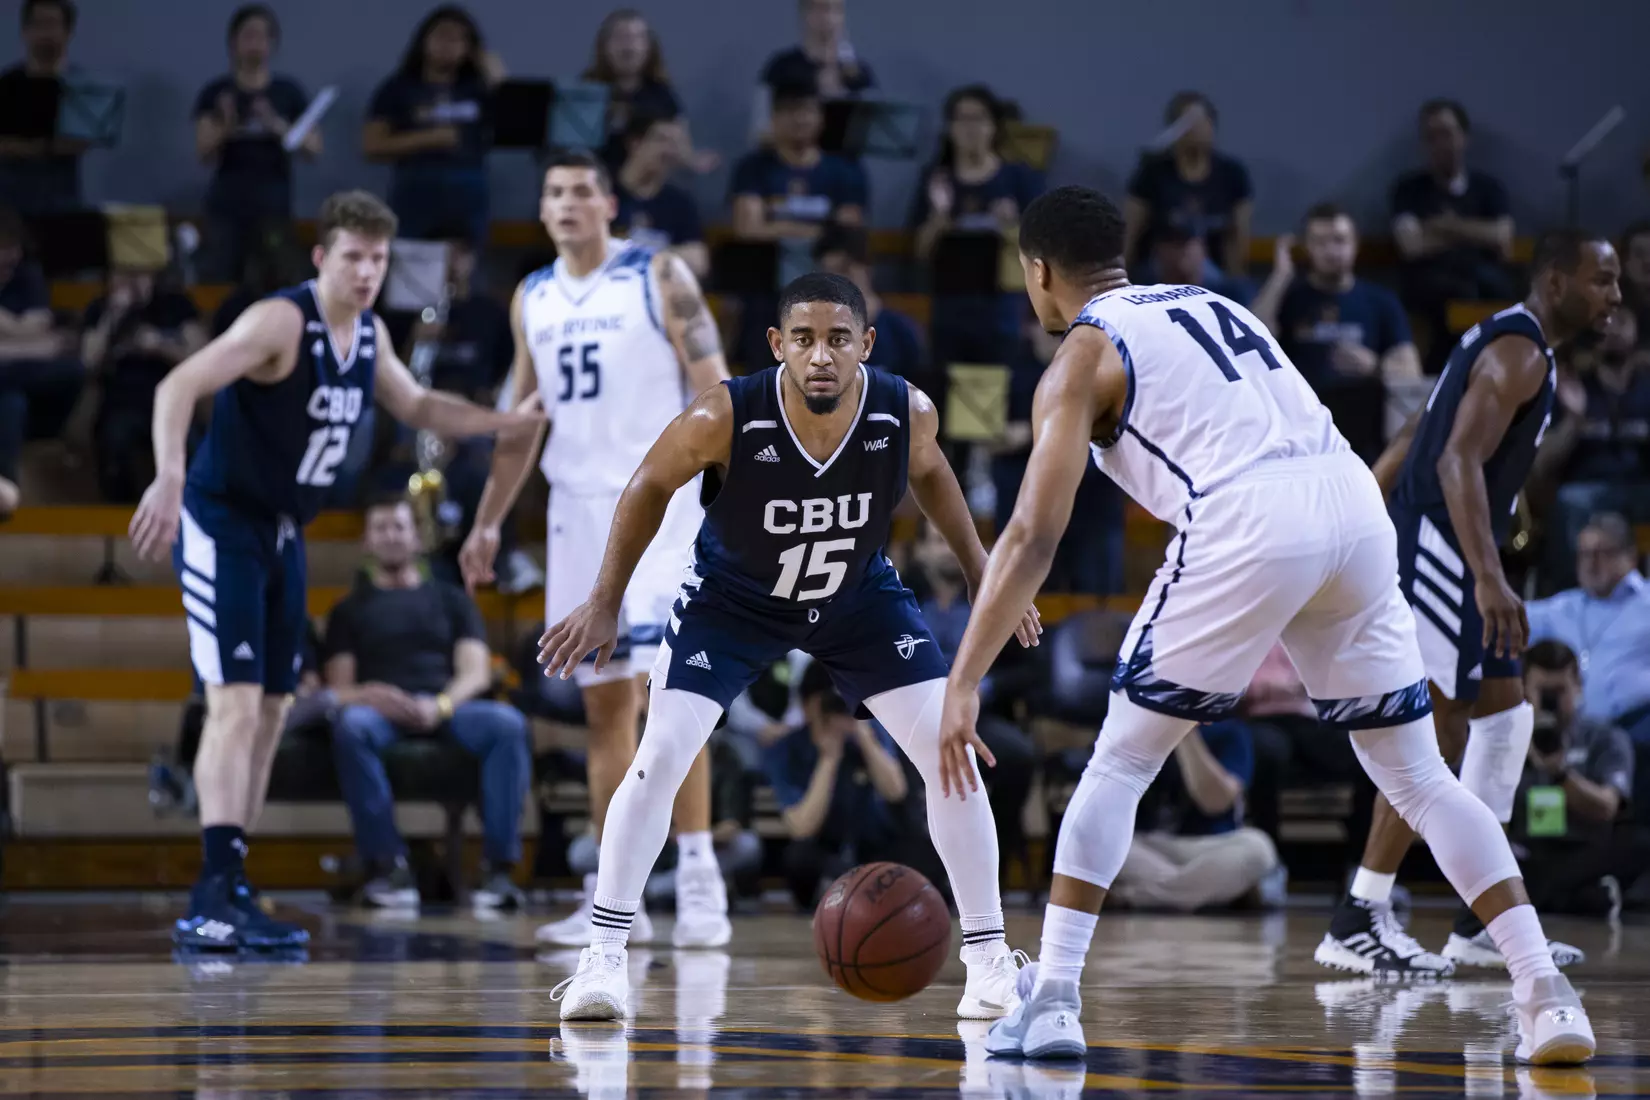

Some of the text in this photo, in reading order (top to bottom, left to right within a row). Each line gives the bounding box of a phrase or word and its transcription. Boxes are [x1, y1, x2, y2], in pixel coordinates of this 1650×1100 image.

[1120, 286, 1208, 305] LEONARD
[1165, 301, 1283, 383] 14
[558, 342, 601, 402] 55
[306, 385, 363, 424] CBU
[296, 425, 350, 487] 12
[753, 454, 780, 463] adidas
[863, 437, 889, 451] WAC
[763, 492, 872, 534] CBU
[770, 537, 856, 601] 15
[685, 659, 712, 670] adidas
